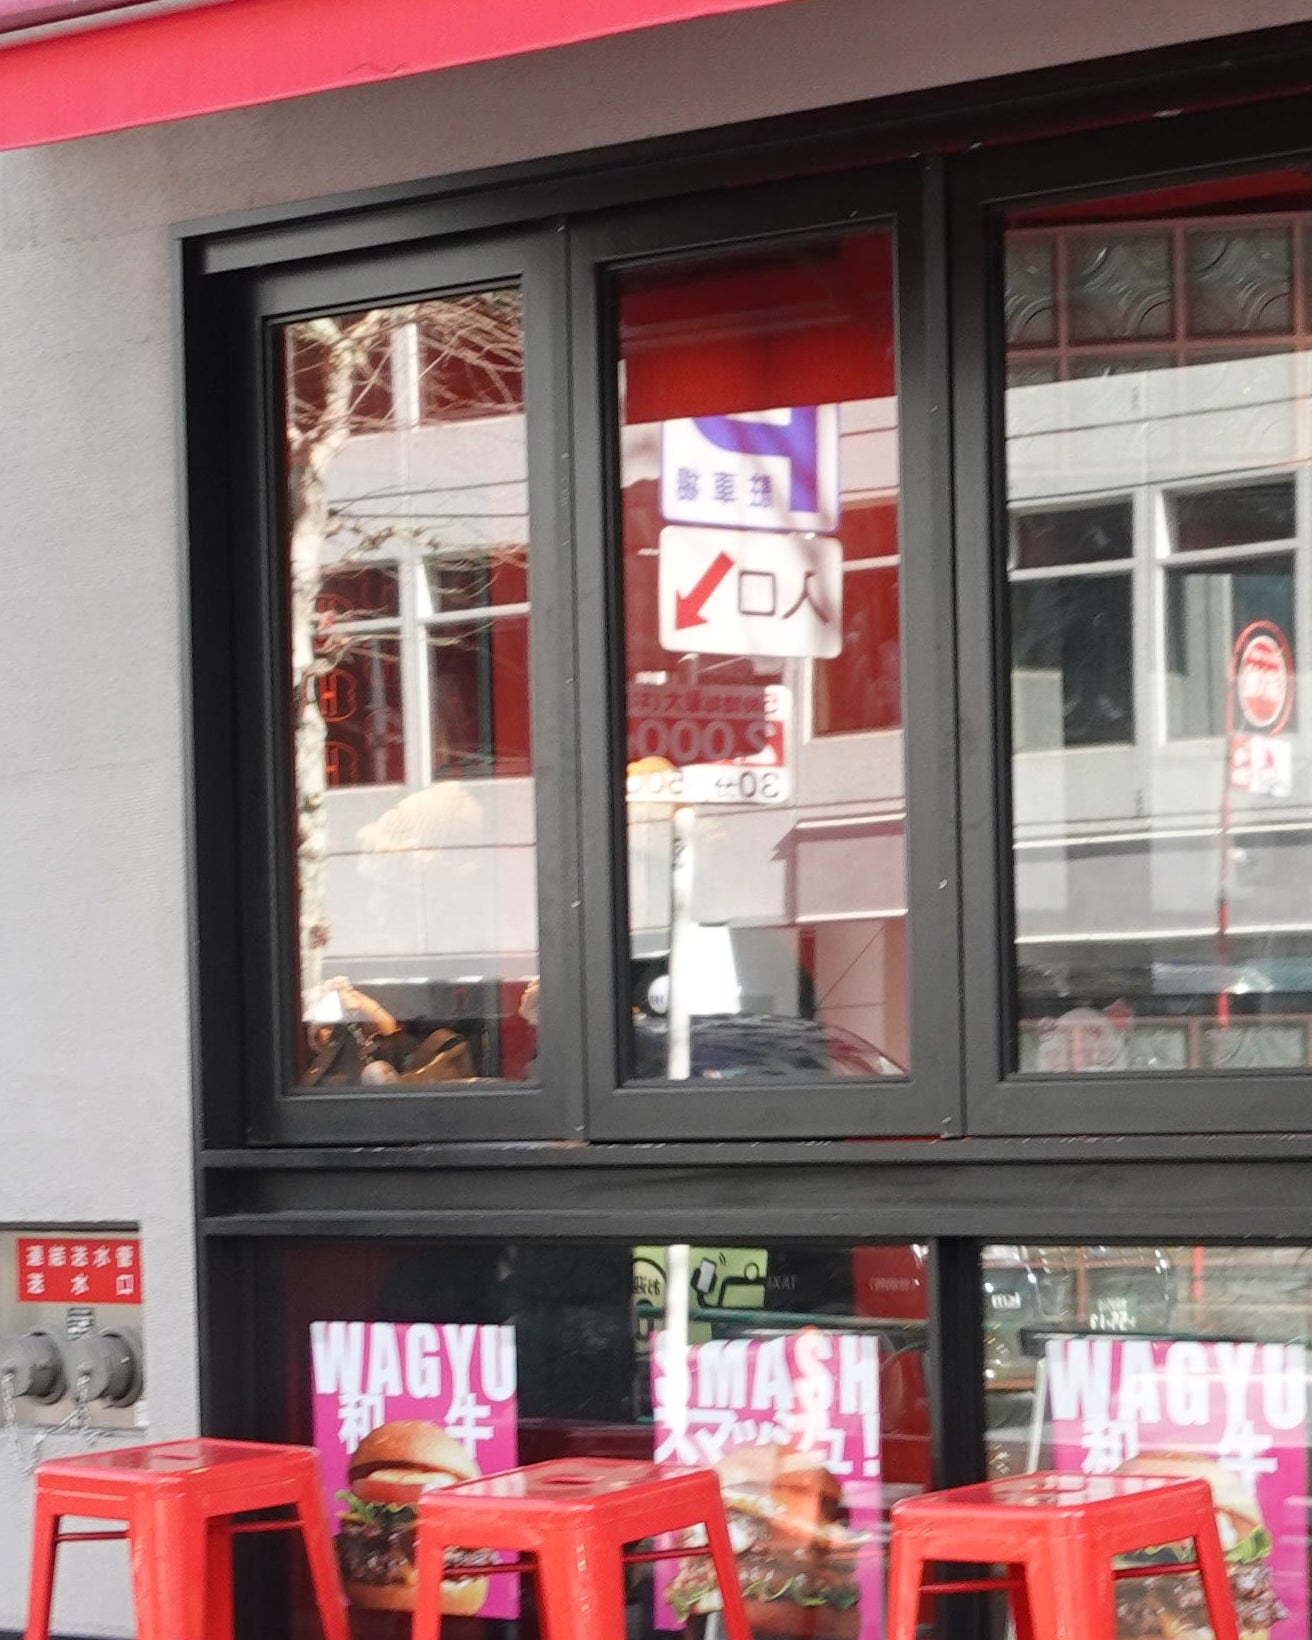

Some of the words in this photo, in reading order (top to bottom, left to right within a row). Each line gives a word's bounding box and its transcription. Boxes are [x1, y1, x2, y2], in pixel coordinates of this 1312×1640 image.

[310, 1321, 518, 1402] WAGYU
[654, 1328, 880, 1416] SMASH
[1046, 1338, 1307, 1430] WAGYU
